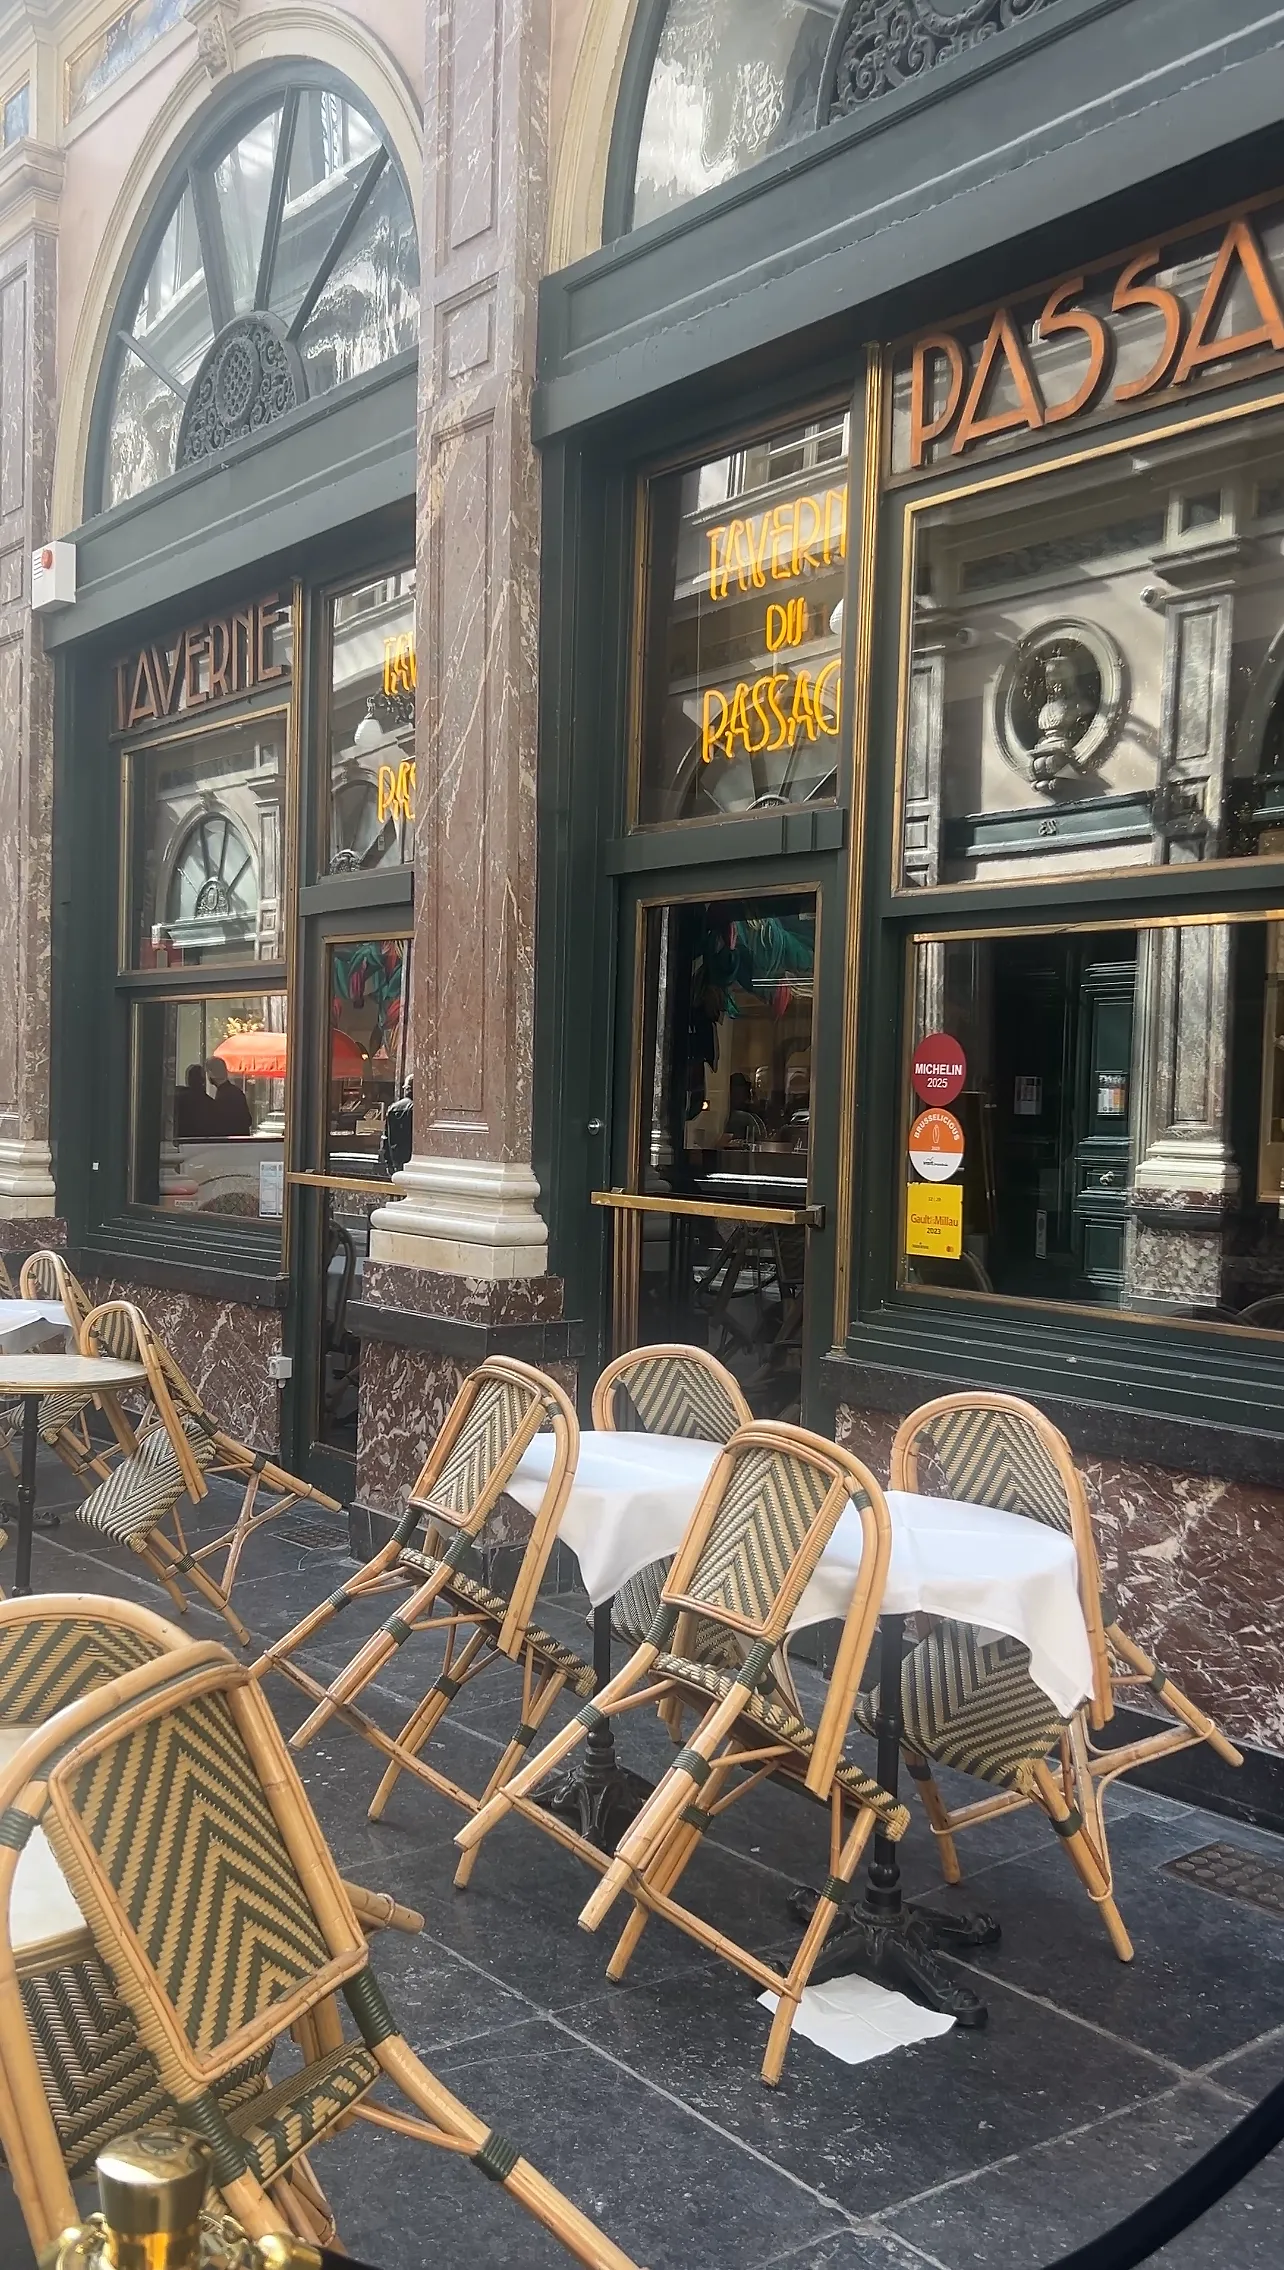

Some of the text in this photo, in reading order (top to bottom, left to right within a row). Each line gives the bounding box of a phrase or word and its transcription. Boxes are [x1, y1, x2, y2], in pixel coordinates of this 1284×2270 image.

[910, 219, 1284, 468] PASSA
[766, 597, 805, 651] DU
[112, 593, 284, 731] TAVERNE
[914, 1063, 963, 1075] MICHELIN
[926, 1078, 948, 1088] 2025
[913, 1113, 961, 1141] BRUSSELICIOUS
